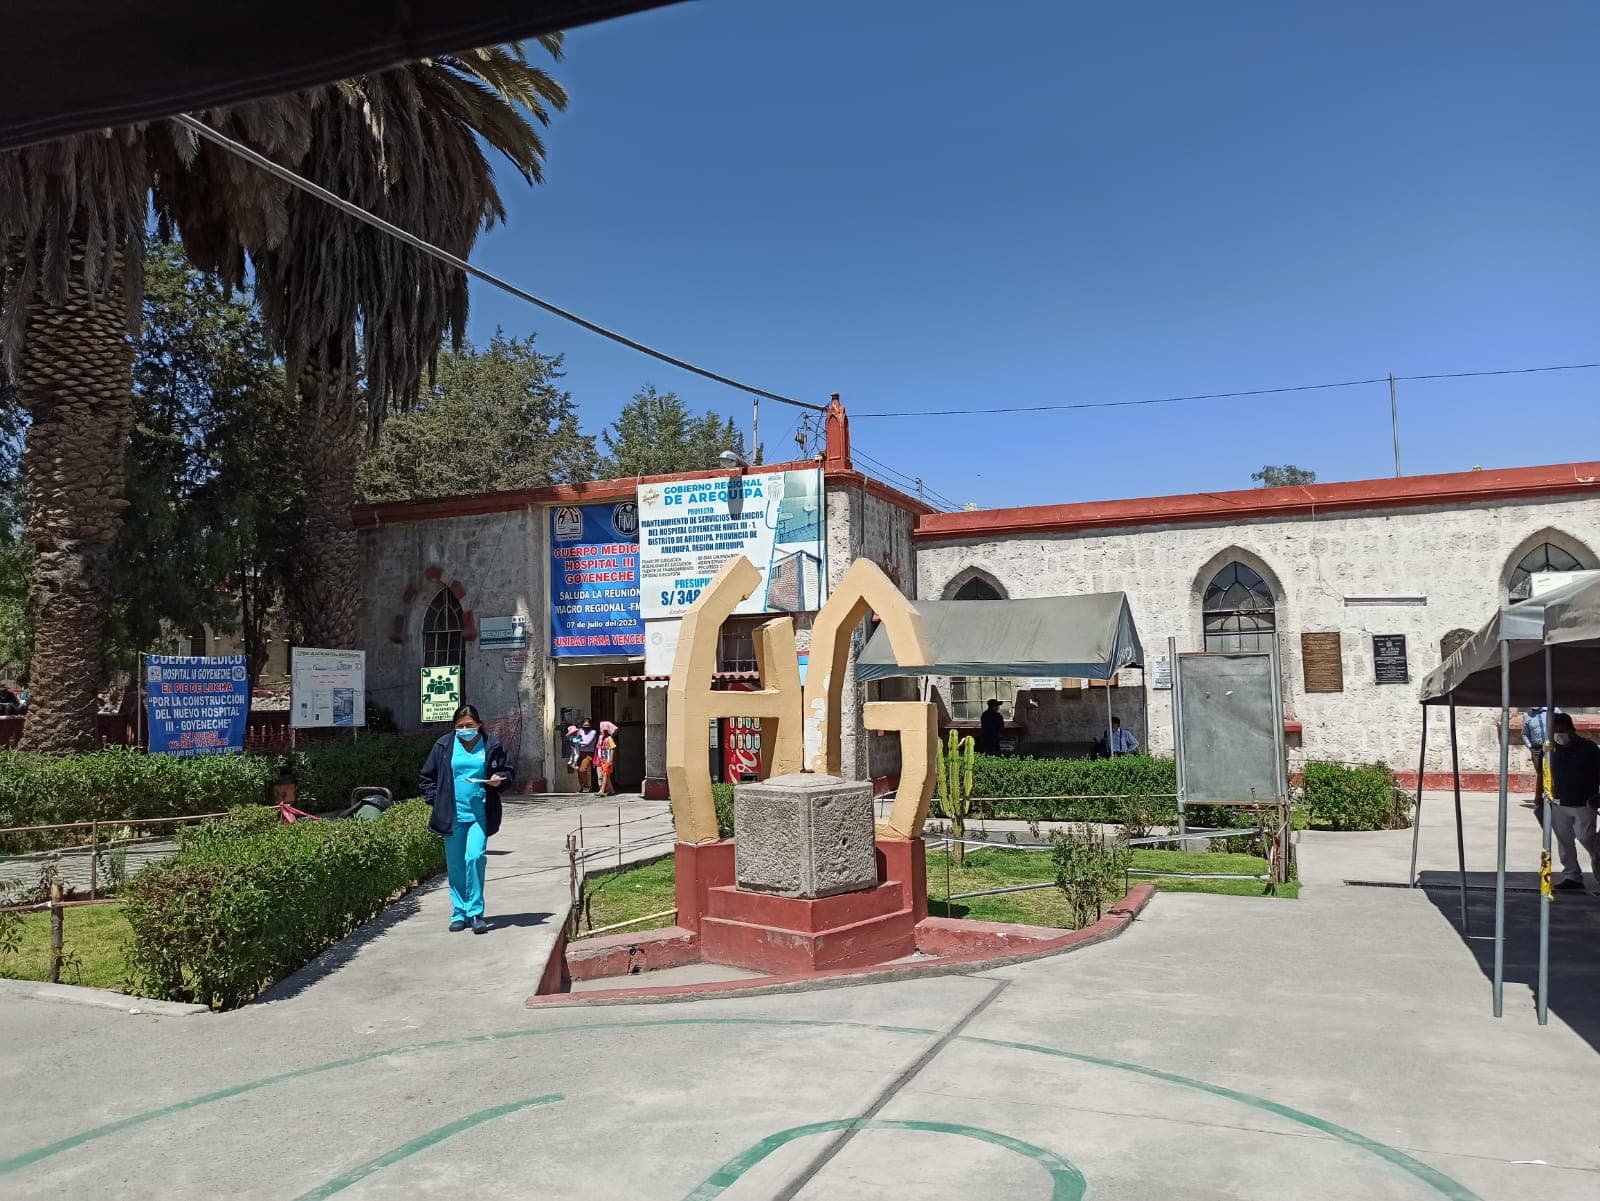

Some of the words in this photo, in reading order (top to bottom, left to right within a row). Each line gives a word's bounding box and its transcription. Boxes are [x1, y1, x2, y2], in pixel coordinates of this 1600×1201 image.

[664, 483, 712, 495] GOBIERNO
[715, 479, 763, 490] REGIONAL
[664, 495, 683, 506] DE
[688, 488, 763, 504] AREQUIPA
[641, 518, 689, 528] MANTENIMIENTO
[690, 516, 697, 525] DE
[698, 513, 730, 523] SERVICIOS
[648, 528, 658, 537] DEL
[660, 526, 687, 536] HOSPITAL
[688, 523, 722, 534] GOYENECHE
[723, 522, 739, 531] NIVEL
[648, 537, 675, 546] DISTRITO
[676, 536, 684, 544] DE
[715, 531, 749, 541] PROVINCIA
[749, 530, 757, 539] DE
[555, 546, 598, 558] CUERPO
[715, 541, 744, 551] AREQUIPA
[565, 559, 619, 571] HOSPITAL
[622, 557, 635, 568] III
[566, 571, 634, 584] GOYENECHE
[560, 590, 590, 600] SALUDA
[592, 590, 602, 599] LA
[661, 591, 675, 606] S/
[555, 605, 583, 614] MACRO
[585, 602, 625, 613] REGIONAL
[587, 620, 603, 629] julio
[618, 619, 637, 627] 2023
[587, 635, 610, 647] PARA
[162, 669, 190, 680] HOSPITAL
[198, 668, 231, 680] GOYENECHE
[162, 683, 173, 693] EN
[174, 683, 189, 693] PIE
[189, 683, 201, 693] DE
[203, 682, 234, 693] LUCHA
[172, 696, 182, 706] LA
[155, 709, 171, 719] DEL
[173, 708, 200, 719] NUEVO
[201, 707, 239, 718] HOSPITAL
[165, 721, 174, 731] III
